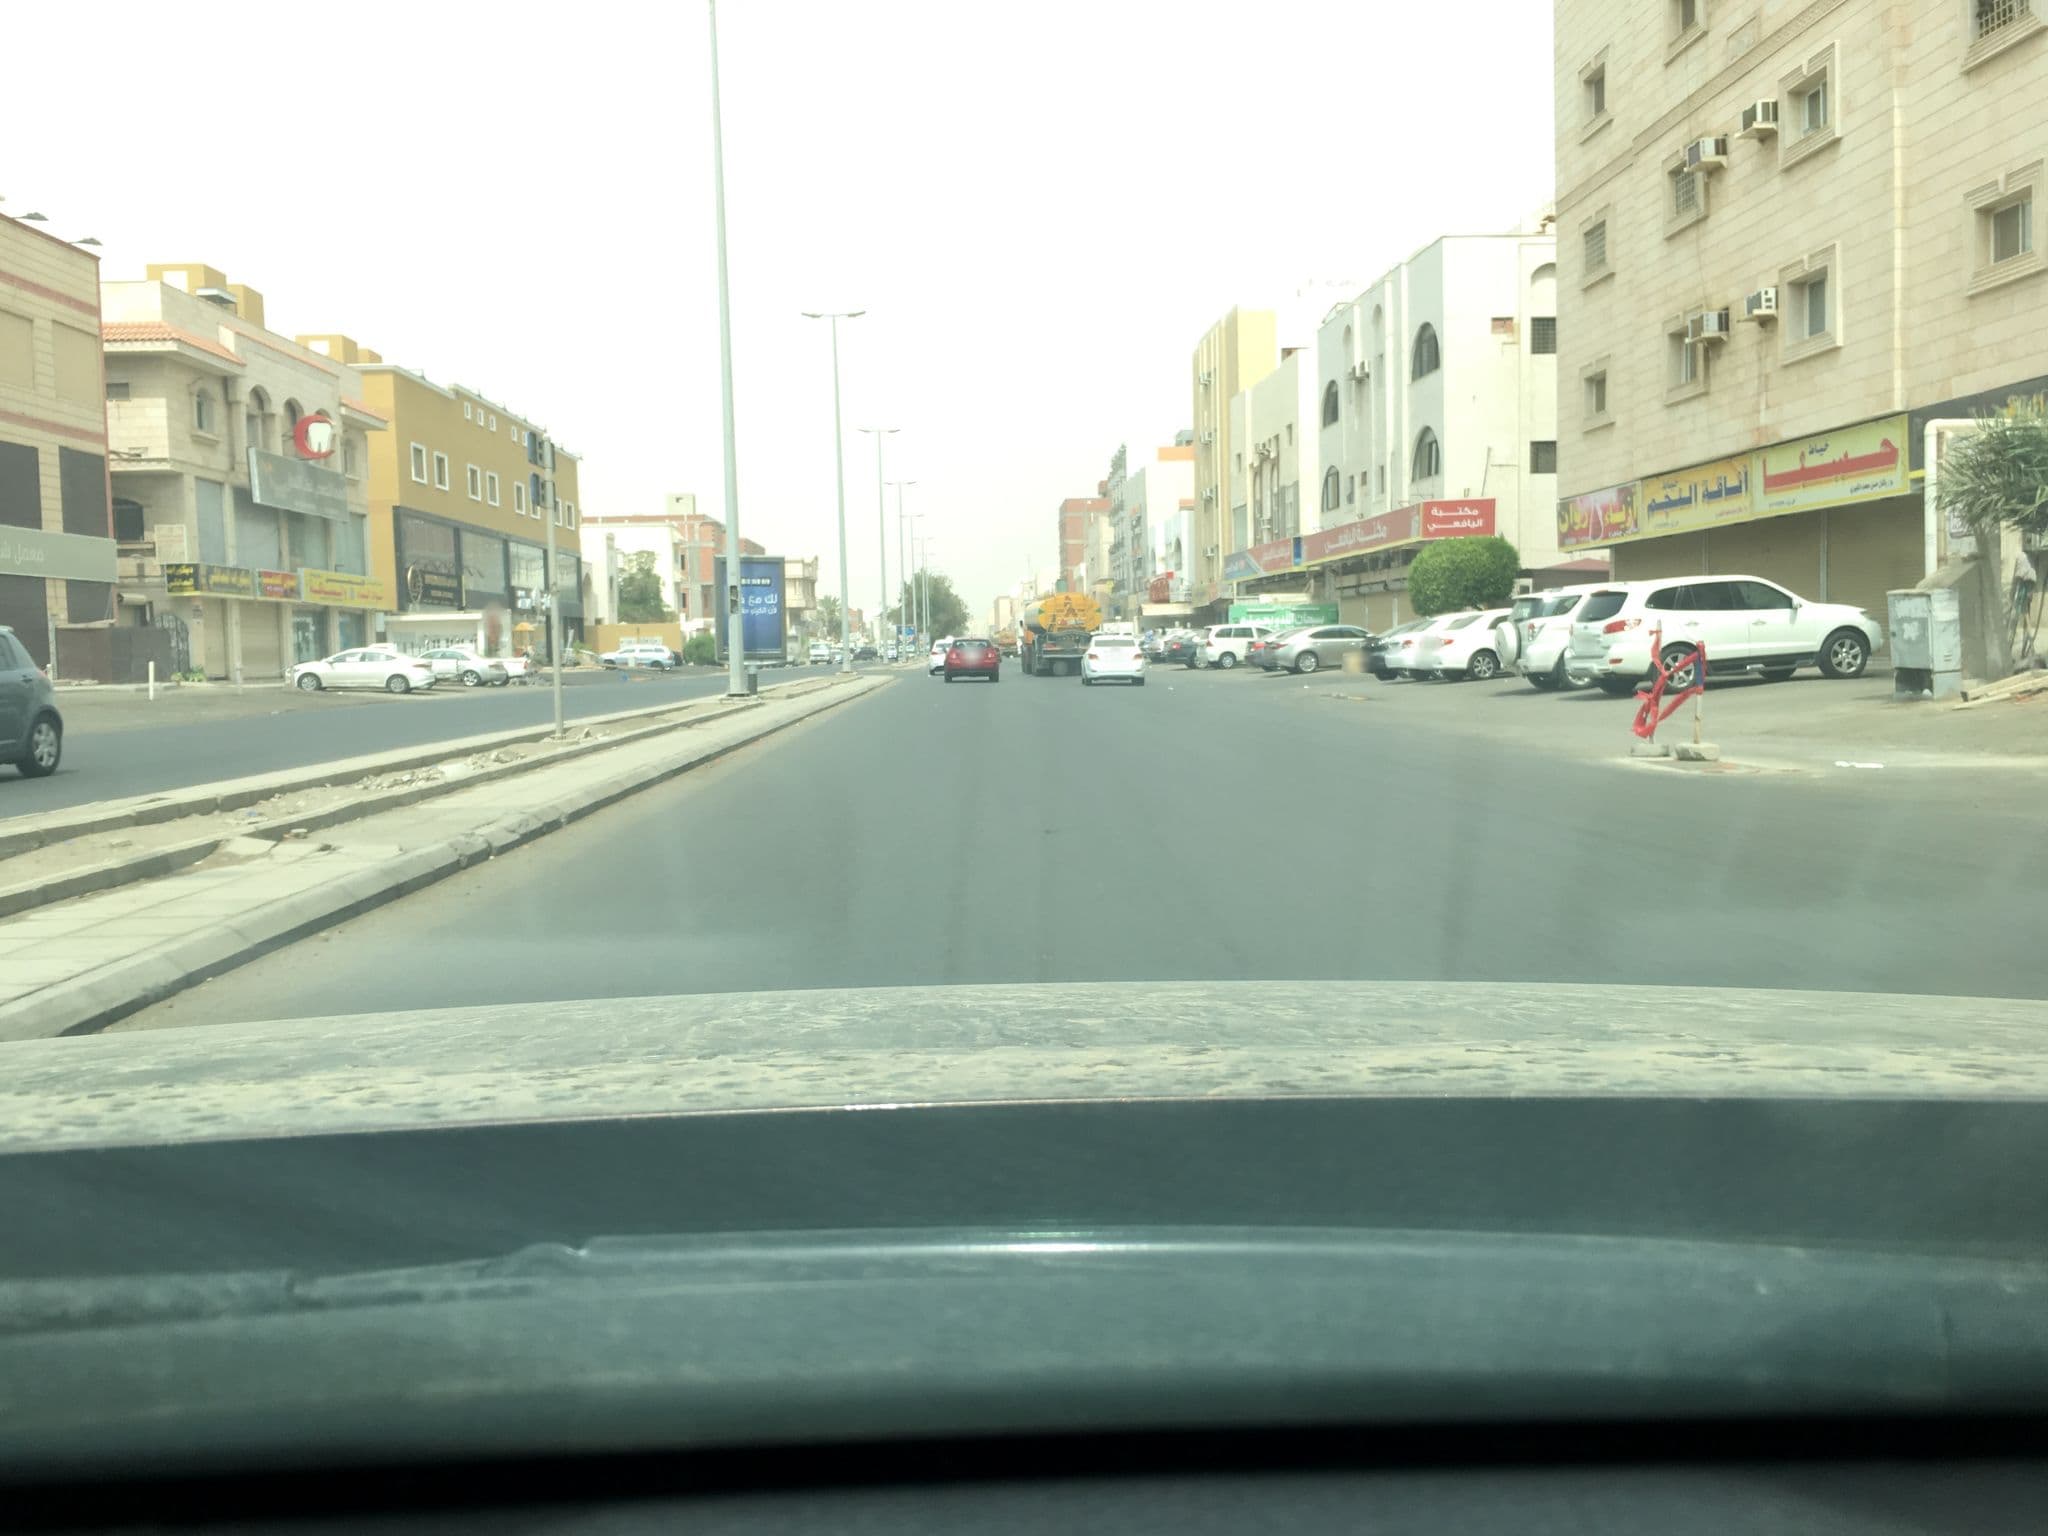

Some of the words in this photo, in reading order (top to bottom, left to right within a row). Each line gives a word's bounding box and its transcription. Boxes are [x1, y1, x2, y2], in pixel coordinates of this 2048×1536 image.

[1807, 442, 1829, 456] خياط
[1431, 506, 1479, 518] مكتبة
[1426, 518, 1483, 533] اليافعي
